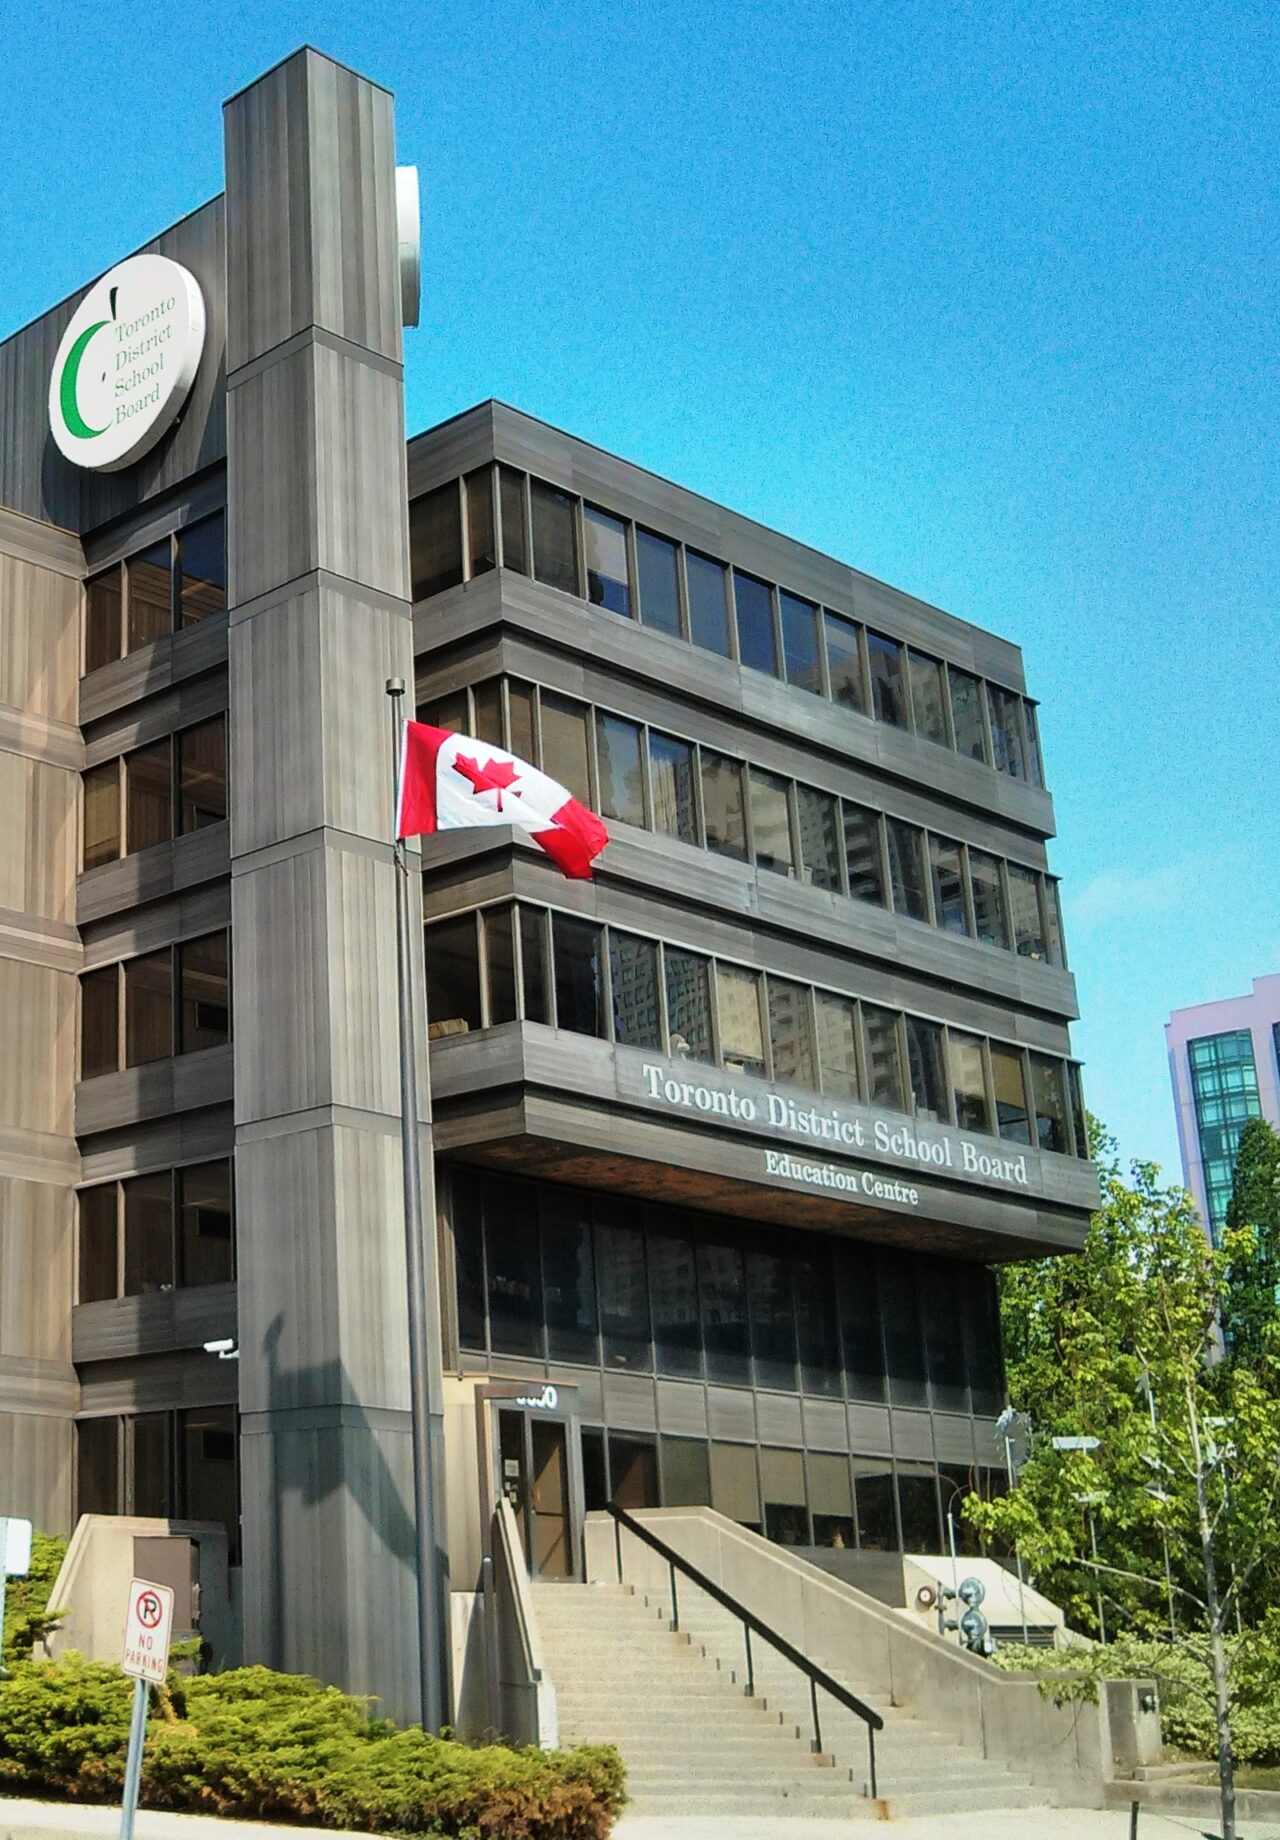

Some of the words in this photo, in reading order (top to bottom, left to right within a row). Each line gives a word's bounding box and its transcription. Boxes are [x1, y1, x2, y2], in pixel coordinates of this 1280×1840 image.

[115, 296, 176, 343] Toronto
[115, 324, 173, 371] District
[114, 353, 165, 398] School
[115, 383, 160, 425] Board
[642, 1063, 756, 1120] Toronto
[766, 1093, 864, 1147] District
[874, 1119, 953, 1167] School
[960, 1141, 1028, 1185] Board
[765, 1149, 858, 1193] Education
[862, 1171, 919, 1206] Centre
[125, 1648, 163, 1673] PARKING
[138, 1633, 153, 1650] NO
